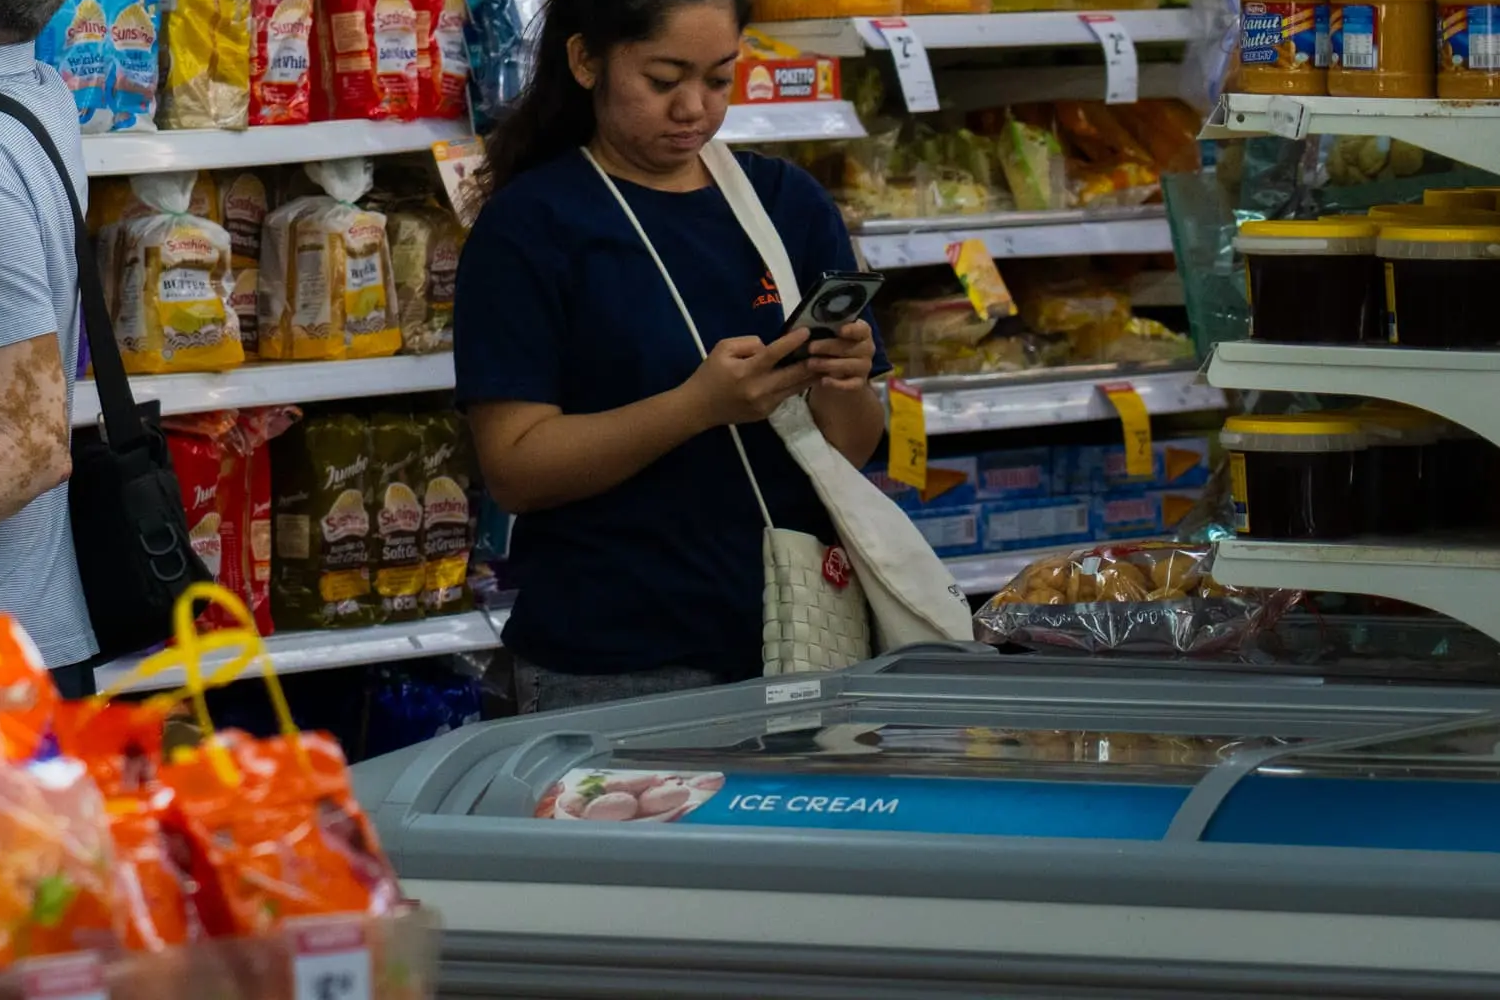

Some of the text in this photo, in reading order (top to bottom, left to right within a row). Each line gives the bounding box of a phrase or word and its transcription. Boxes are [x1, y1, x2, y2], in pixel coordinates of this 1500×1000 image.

[1242, 15, 1280, 31] eanut
[111, 25, 155, 44] Sunsine
[774, 67, 815, 85] POKETTO
[323, 454, 369, 490] Jumbo
[727, 793, 900, 816] ICE CREAM
